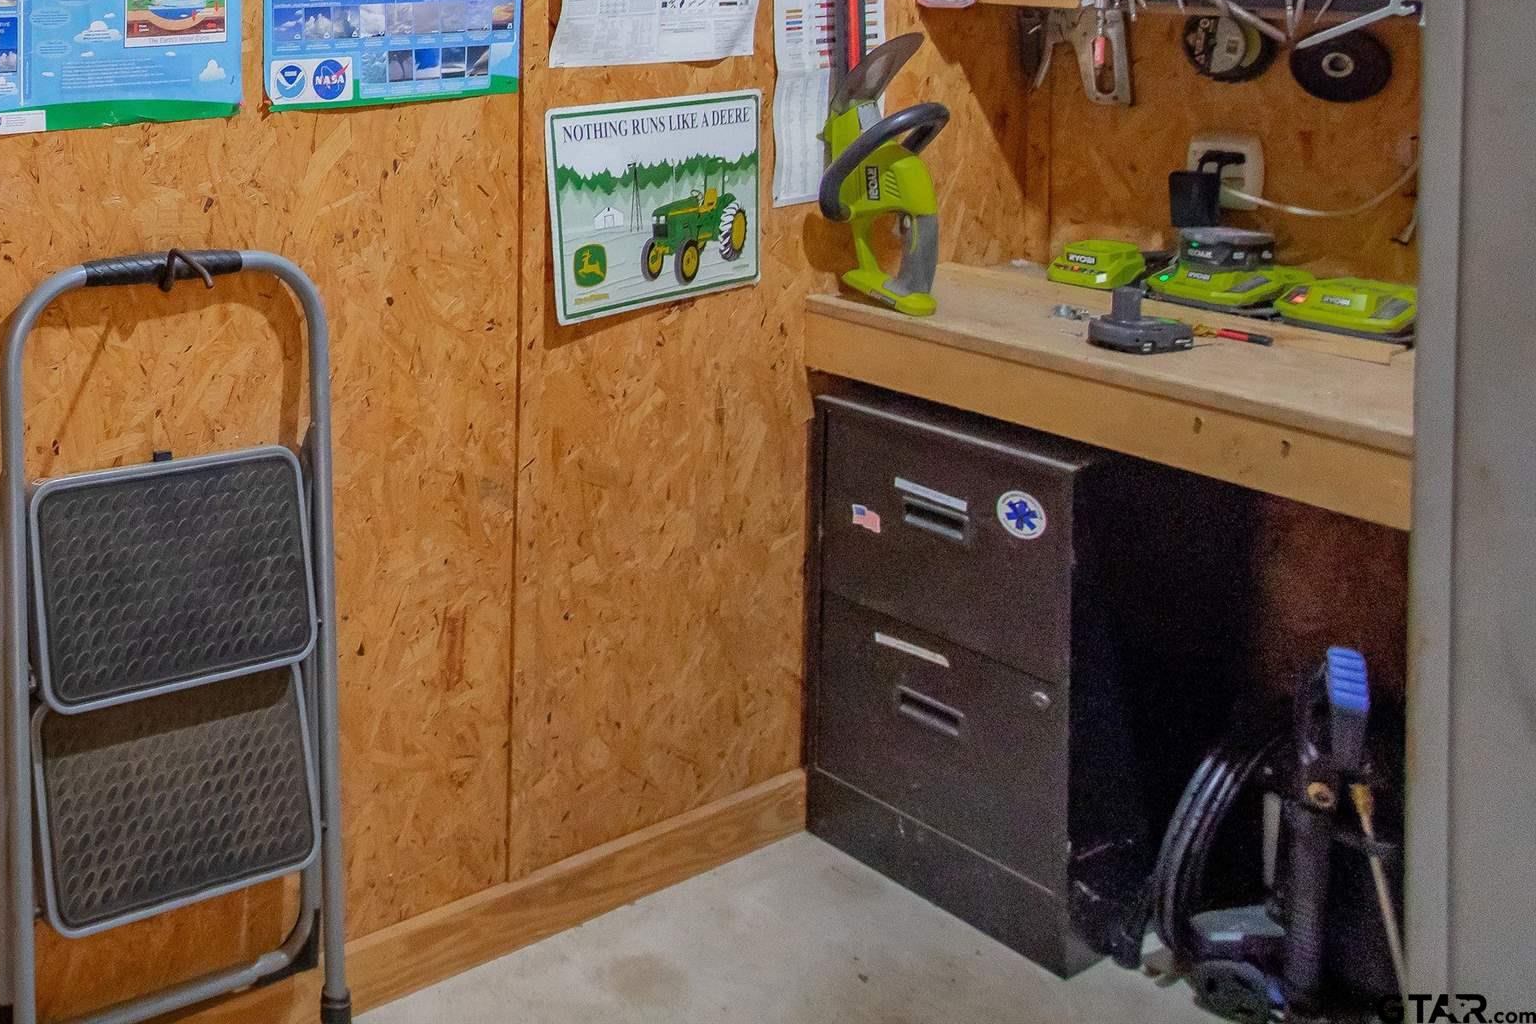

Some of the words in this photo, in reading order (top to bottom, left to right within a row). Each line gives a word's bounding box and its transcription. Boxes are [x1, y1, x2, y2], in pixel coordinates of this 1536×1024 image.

[315, 75, 344, 85] NASA
[562, 120, 628, 144] NOTHING
[632, 115, 665, 136] RUNS
[669, 113, 698, 132] LIKE
[702, 112, 710, 127] A
[712, 106, 750, 126] DEERE
[866, 166, 880, 200] RYOBI
[1068, 255, 1095, 264] RYOBI
[1189, 272, 1211, 280] RYOBI
[1323, 294, 1351, 306] RYOBI
